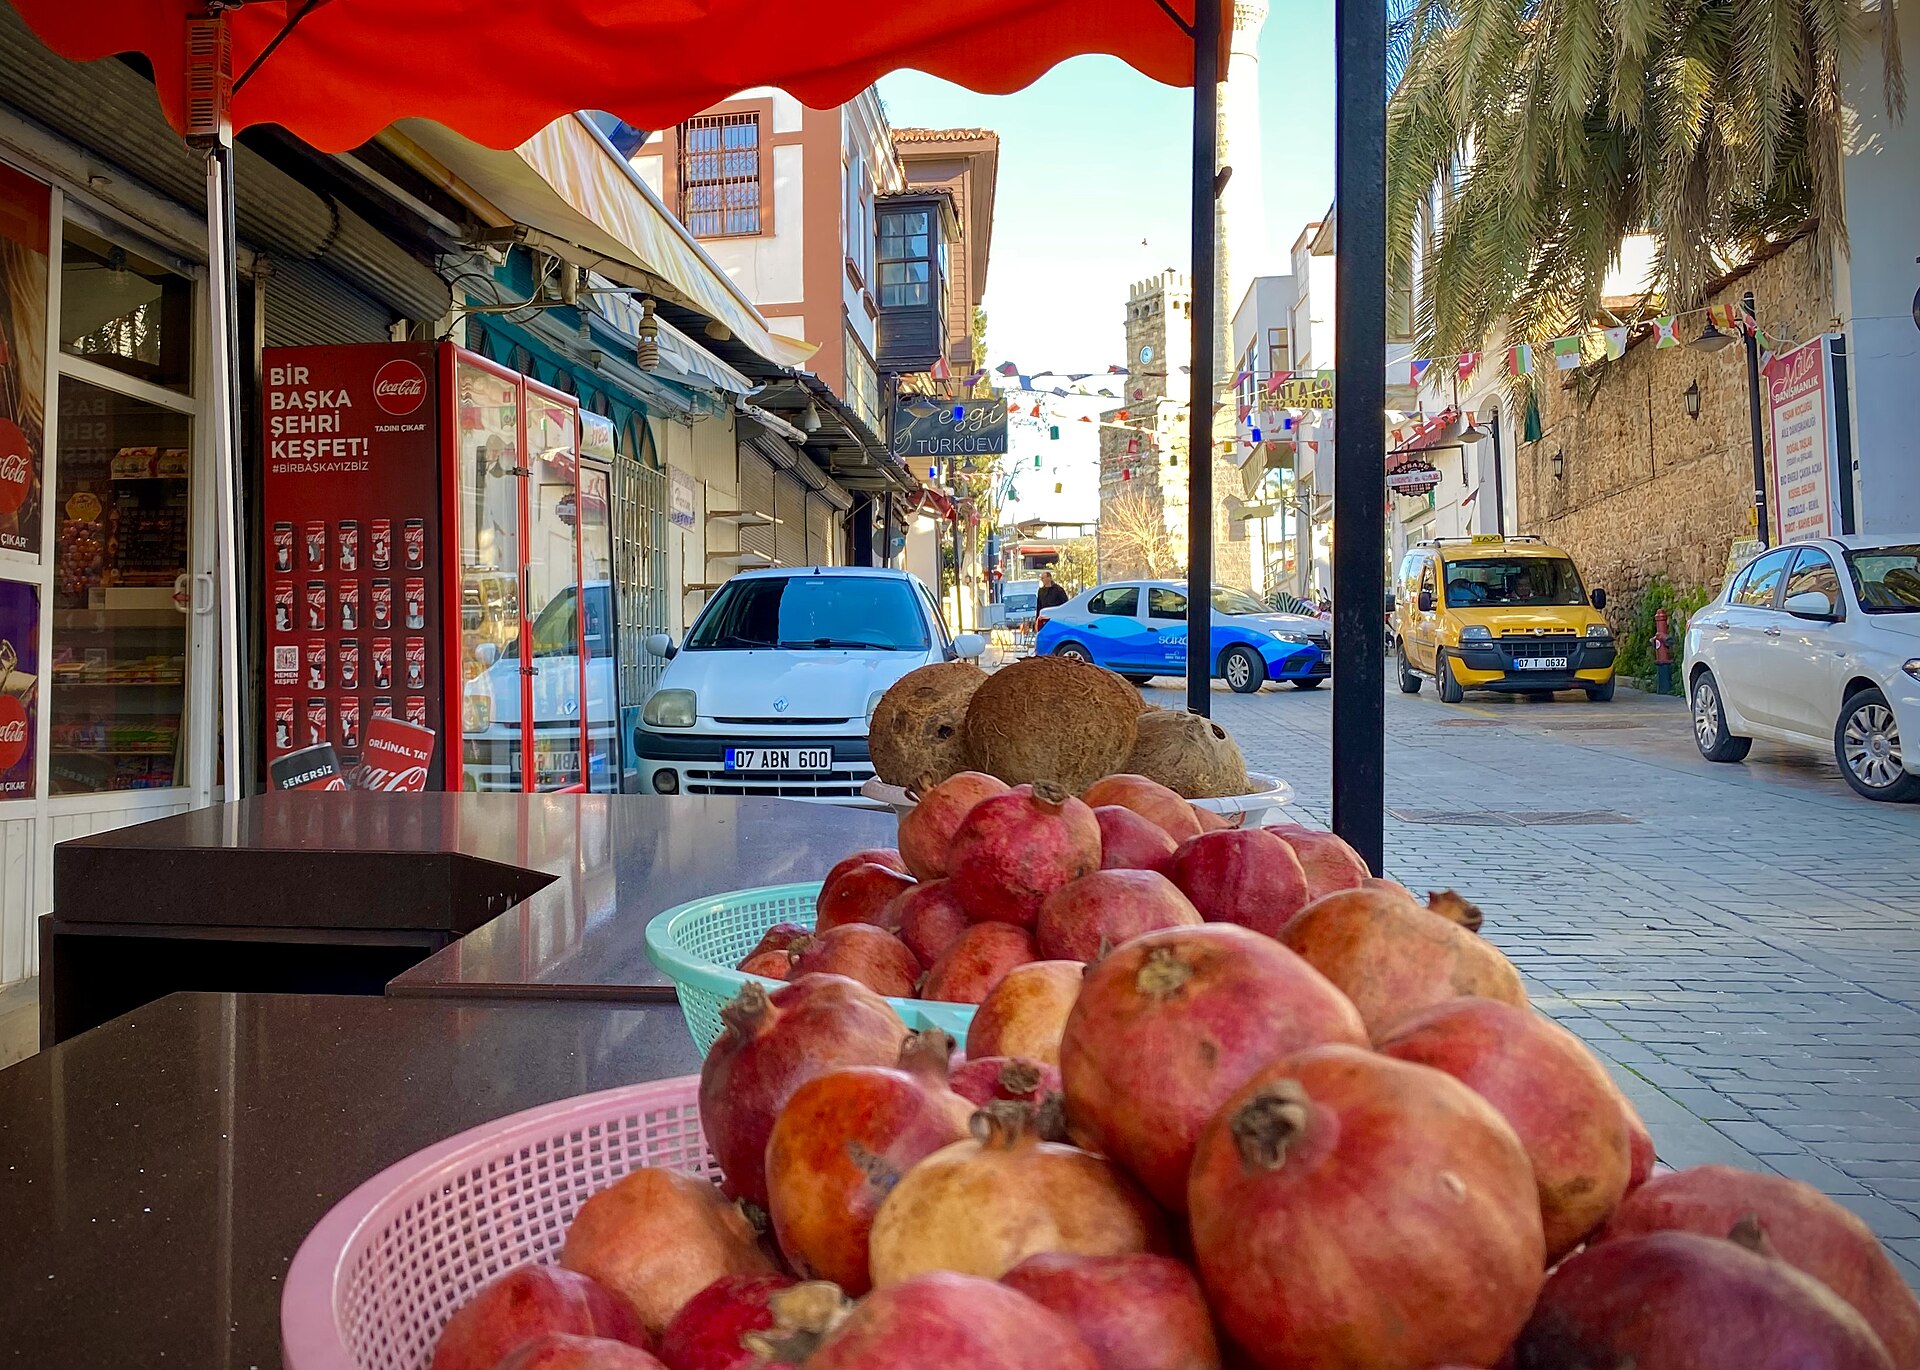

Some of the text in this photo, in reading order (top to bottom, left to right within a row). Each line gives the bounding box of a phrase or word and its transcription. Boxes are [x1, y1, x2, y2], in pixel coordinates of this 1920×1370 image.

[270, 363, 309, 386] BİR
[376, 379, 423, 396] Coca-Cola
[270, 390, 352, 412] BAŞKA
[270, 410, 340, 437] ŞEHRİ
[271, 438, 369, 461] KEŞFET!
[272, 460, 369, 473] #BİRBAŞKAYIZBİZ
[1519, 658, 1565, 668] 07 T 0632
[369, 738, 428, 761] ORİJİNAL TAT
[736, 751, 754, 768] 07
[761, 750, 789, 768] ABN
[799, 751, 828, 768] 600
[282, 764, 333, 789] ŞEKERSİZ
